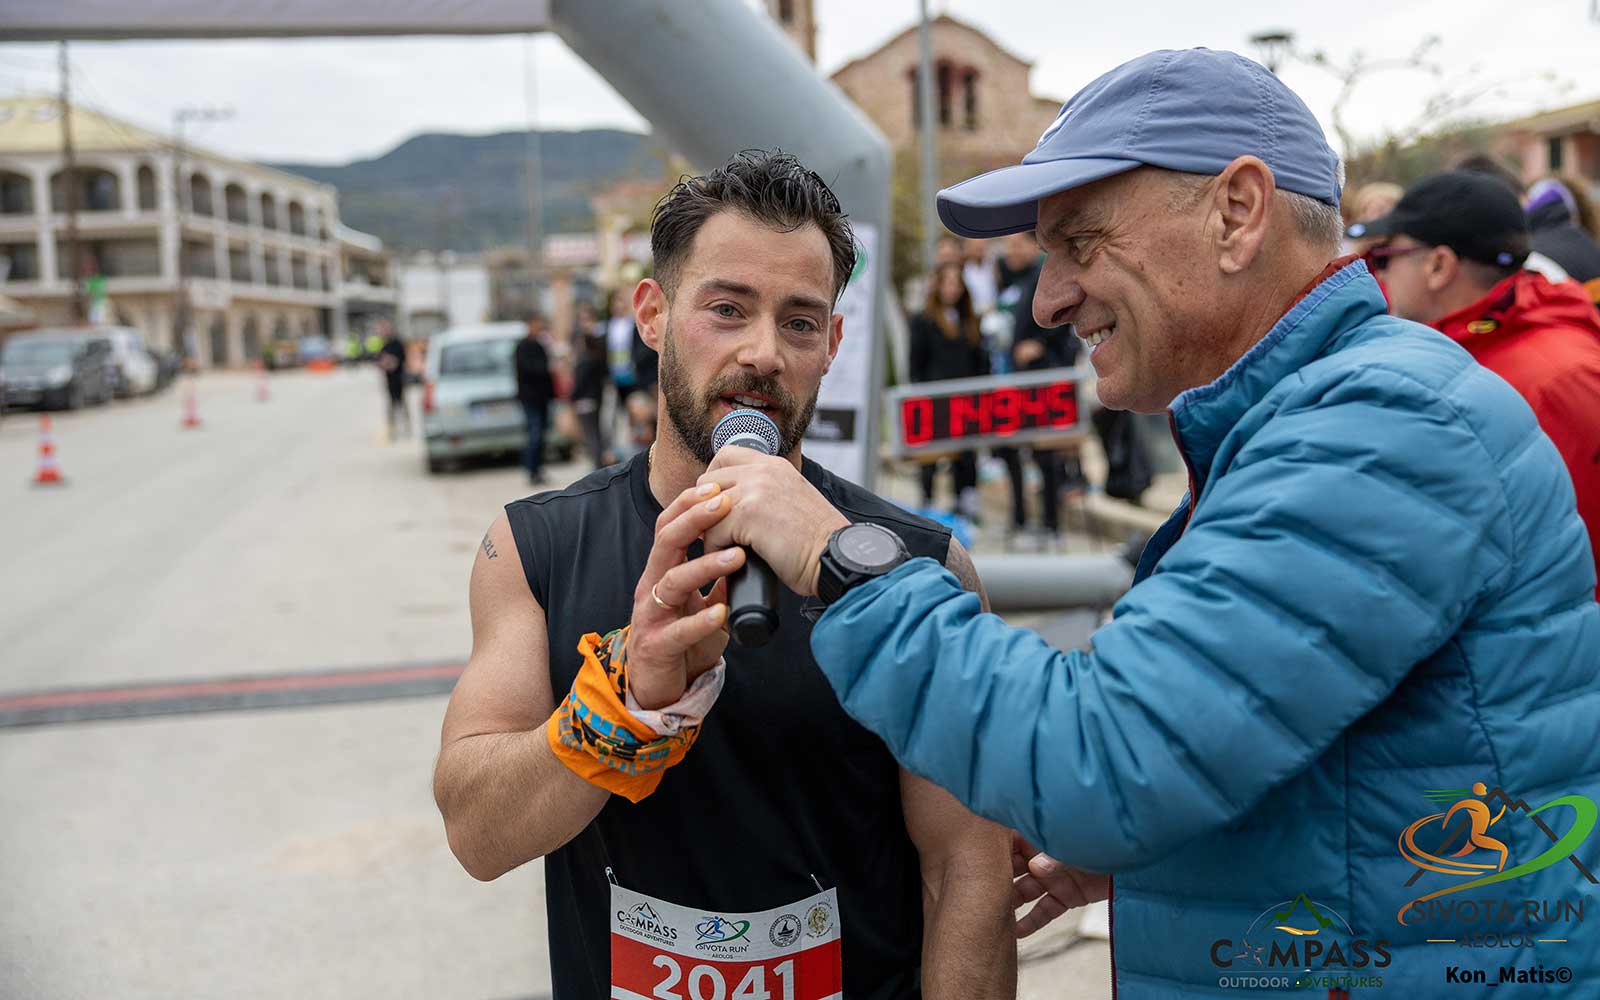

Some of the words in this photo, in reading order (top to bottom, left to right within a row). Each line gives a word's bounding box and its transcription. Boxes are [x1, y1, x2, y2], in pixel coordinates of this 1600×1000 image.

[620, 924, 643, 936] OUTDOOR
[644, 933, 675, 946] ADVENTURES
[698, 944, 728, 953] SIVOTA
[653, 954, 794, 1000] 2041
